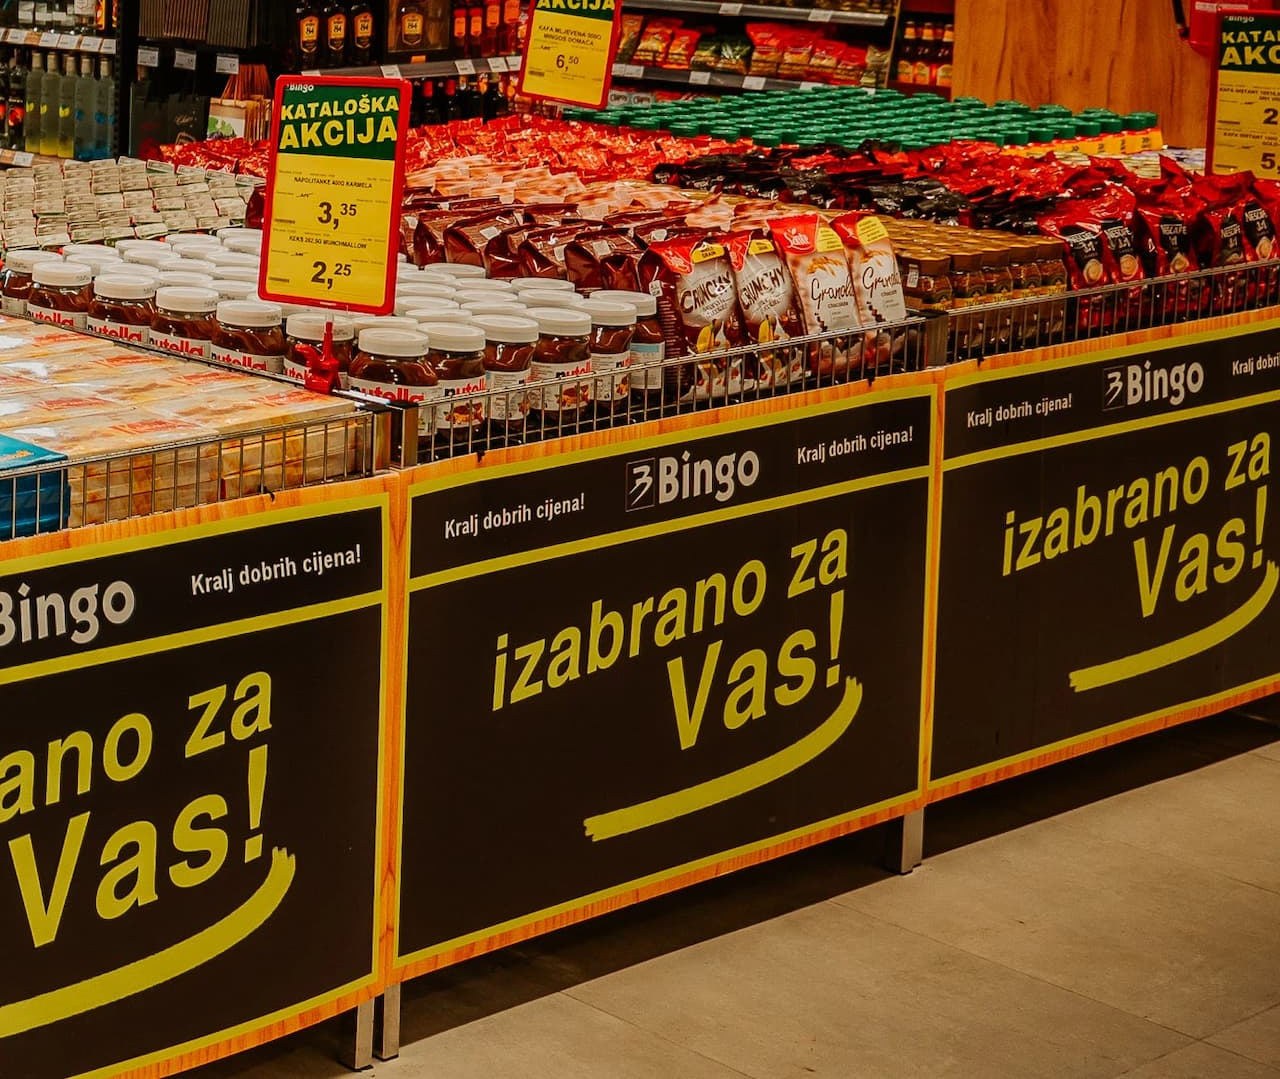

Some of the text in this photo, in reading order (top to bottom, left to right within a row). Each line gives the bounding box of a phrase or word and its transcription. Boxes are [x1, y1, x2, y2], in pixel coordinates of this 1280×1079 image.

[1221, 30, 1280, 44] KATA
[556, 54, 579, 72] 6,50
[281, 94, 399, 120] KATALOŠKA
[279, 116, 397, 149] AKCIJA
[317, 201, 357, 230] 3,35
[311, 260, 352, 290] 2,25
[741, 267, 786, 309] CRUNCHY
[1127, 360, 1204, 406] Bingo
[1232, 358, 1254, 376] Kralj
[968, 392, 1072, 428] Kralj dobrih cijena!
[797, 426, 913, 465] Kralj dobrih cijena!
[658, 450, 760, 502] Bingo
[445, 492, 585, 539] Kralj dobrih cijena!
[1002, 430, 1272, 576] izabrano za
[191, 544, 362, 596] Kralj dobrih cijena!
[1132, 485, 1268, 618] Vas!
[491, 526, 849, 712] izabrano za
[666, 589, 846, 751] Vas!
[185, 670, 272, 759] za
[7, 742, 269, 948] Vas!
